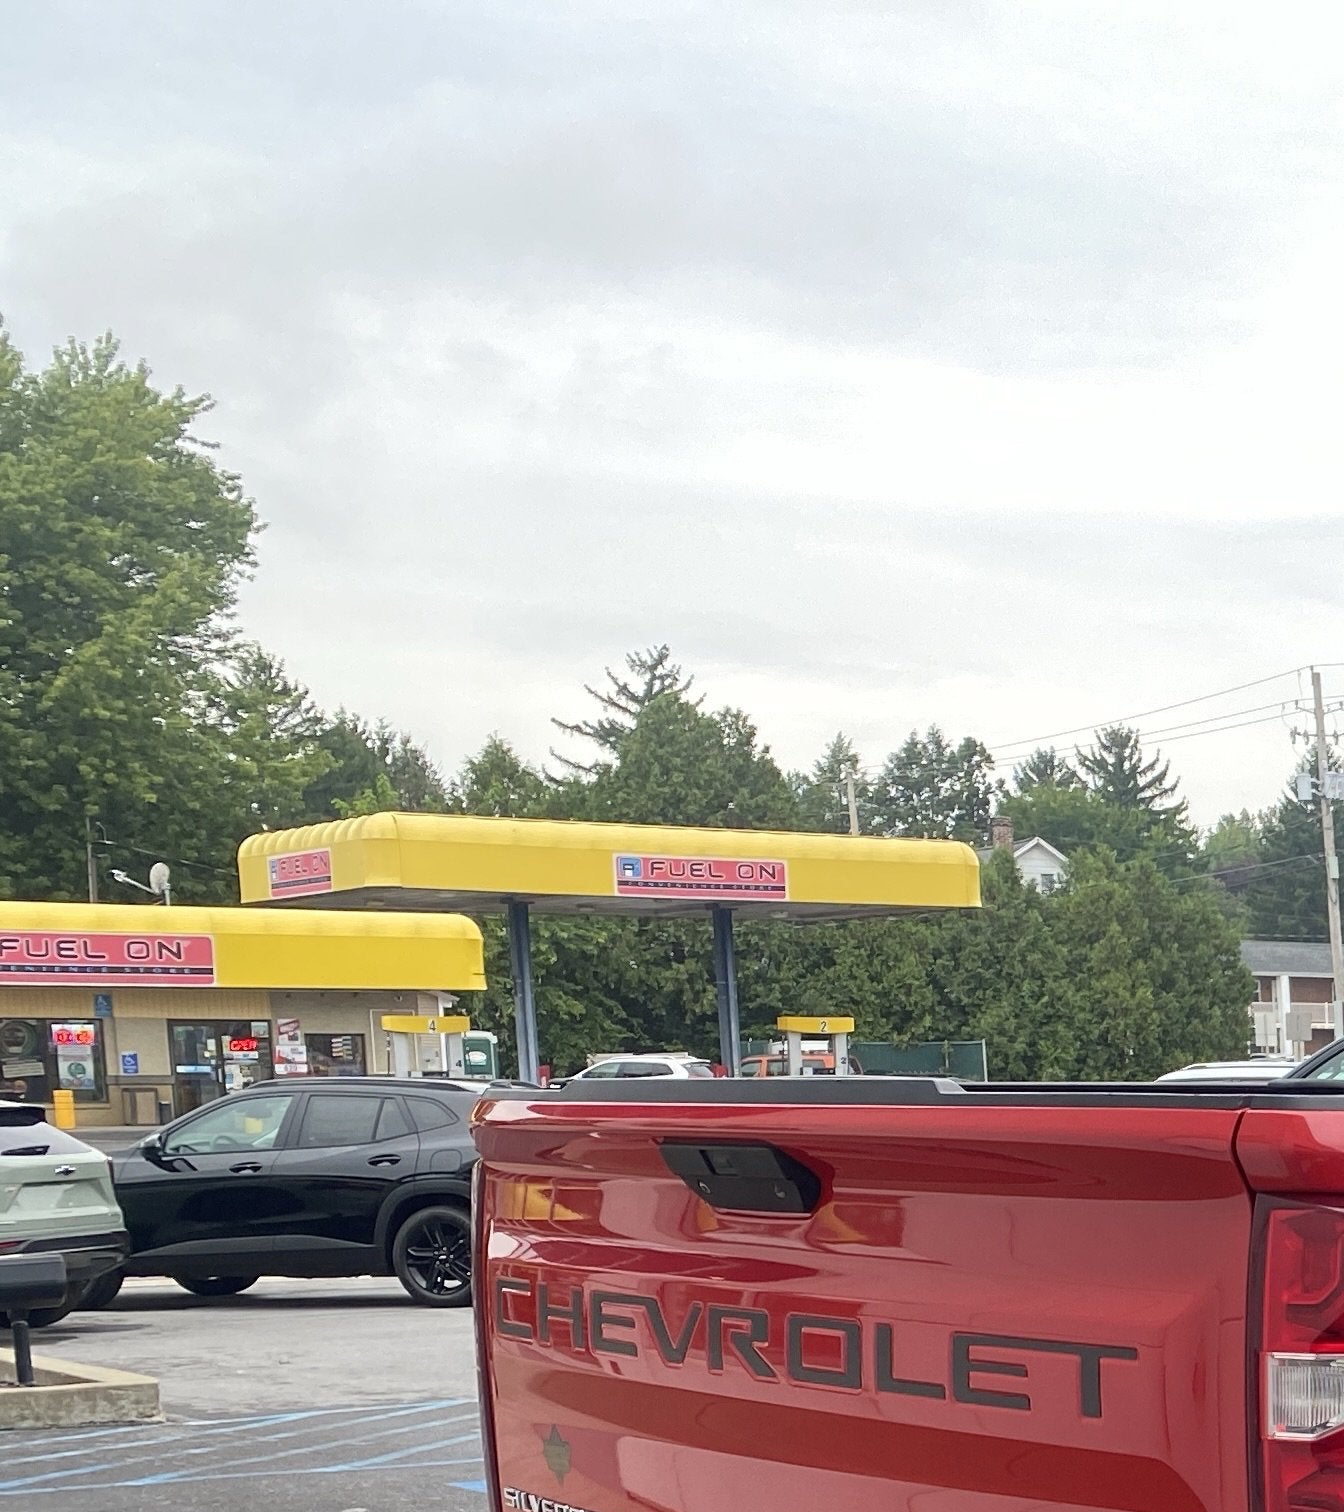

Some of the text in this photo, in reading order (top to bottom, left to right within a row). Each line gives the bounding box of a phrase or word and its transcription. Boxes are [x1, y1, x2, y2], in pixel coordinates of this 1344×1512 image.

[650, 861, 776, 880] FUEL ON
[0, 938, 182, 960] FUEL ON
[429, 1020, 437, 1032] 4
[820, 1020, 828, 1033] 2
[497, 1279, 1138, 1419] CHEVROLET
